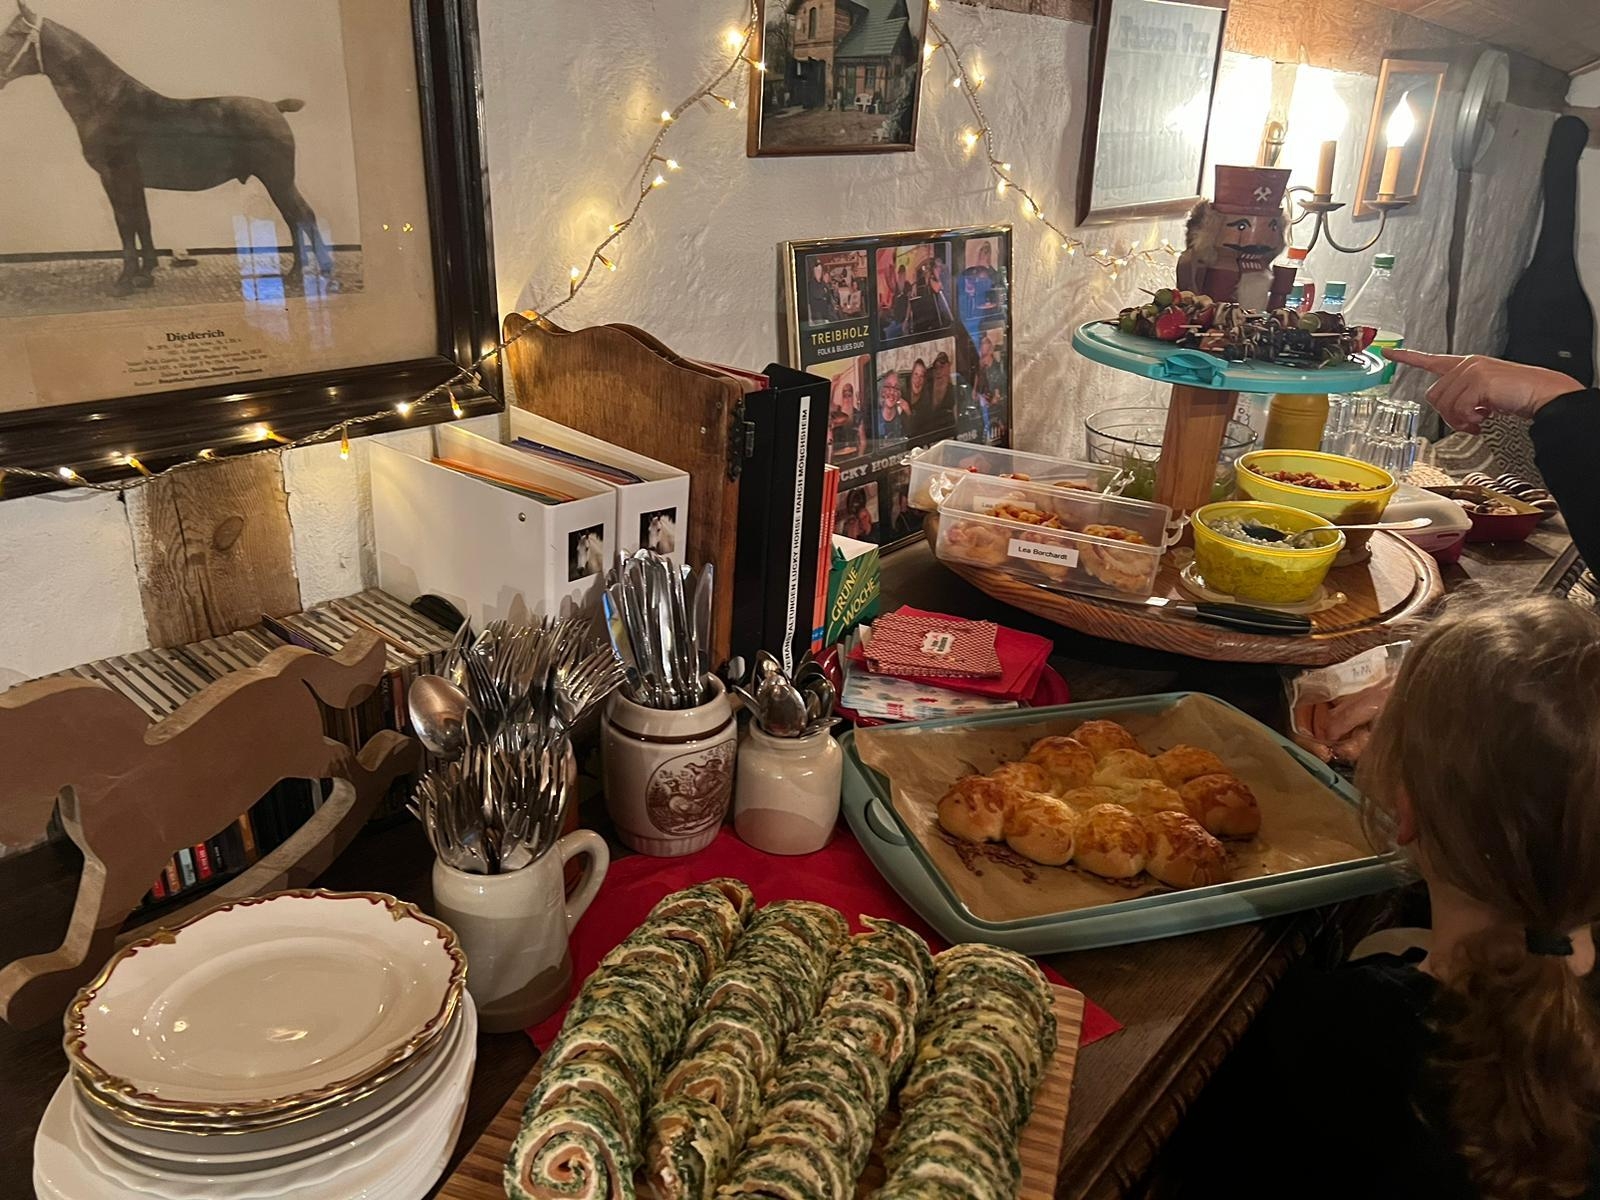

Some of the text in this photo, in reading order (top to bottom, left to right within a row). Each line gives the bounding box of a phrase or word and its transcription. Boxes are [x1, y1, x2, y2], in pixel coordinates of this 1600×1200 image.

[166, 329, 225, 342] Diederich
[811, 325, 869, 346] TREIBHOLZ
[817, 348, 831, 356] FOLK
[836, 343, 853, 352] BLUES
[853, 341, 865, 349] DUO
[840, 464, 870, 482] CKY
[795, 479, 804, 513] RANCH
[793, 515, 801, 549] HORSE
[791, 552, 799, 581] LUCKY
[1018, 546, 1068, 560] Lea Borchardt
[832, 567, 858, 621] GRÜNE
[843, 577, 875, 625] WOCHE
[784, 584, 797, 671] VERANSTALTUNGEN
